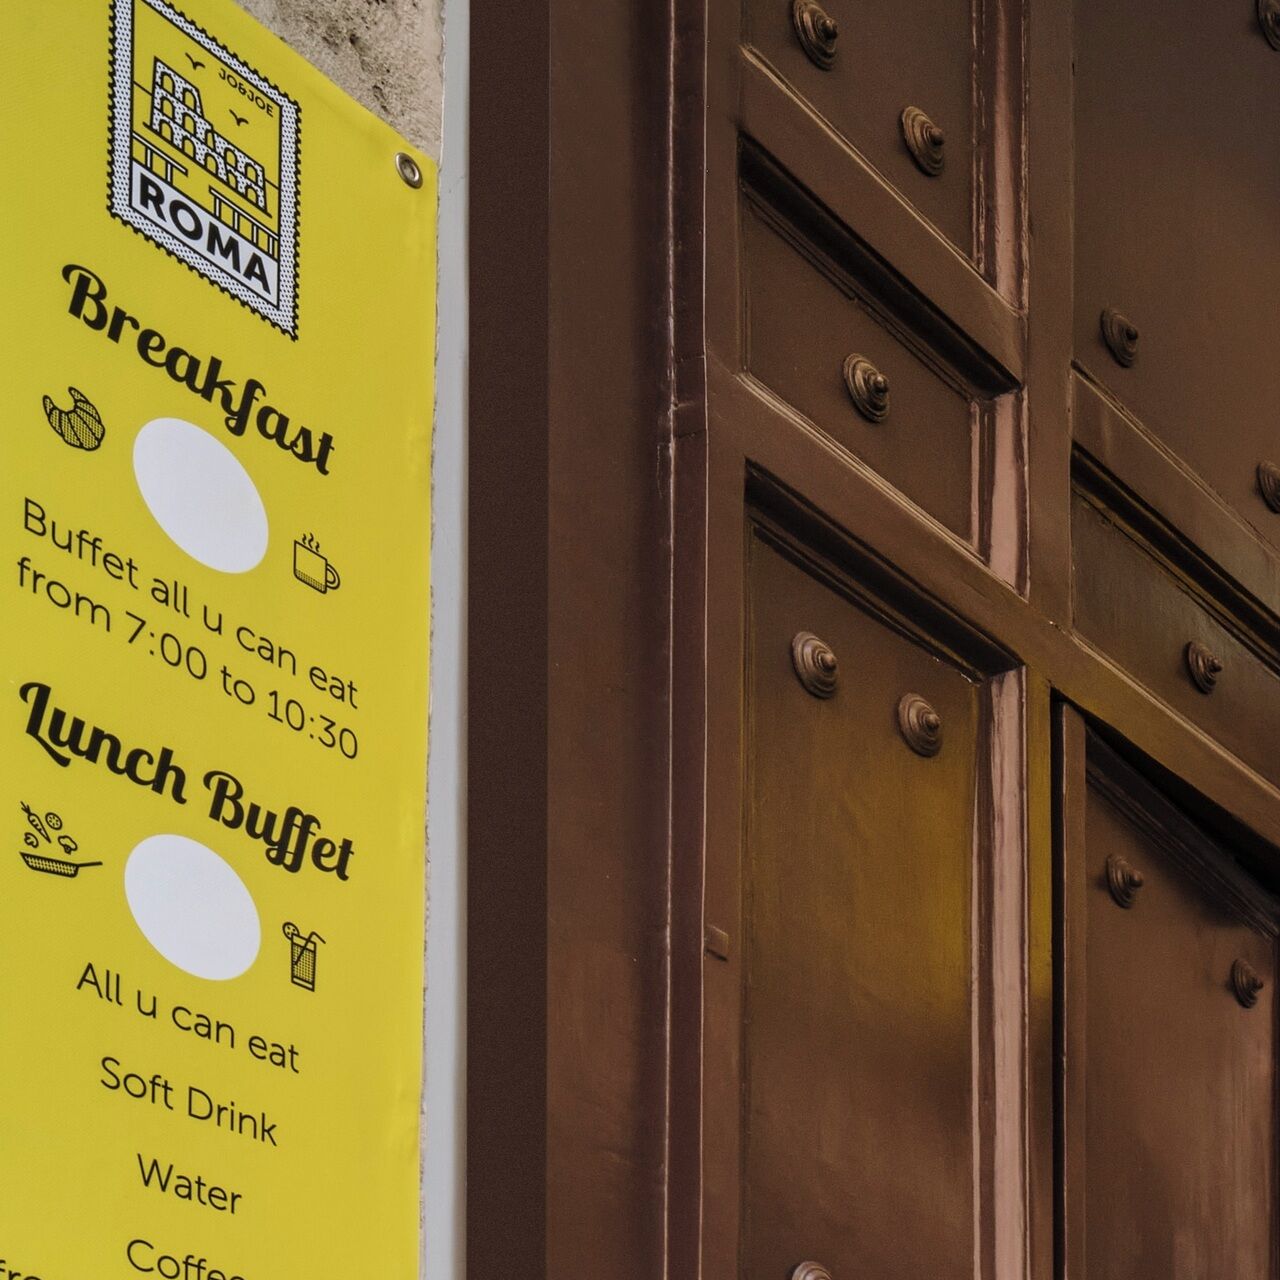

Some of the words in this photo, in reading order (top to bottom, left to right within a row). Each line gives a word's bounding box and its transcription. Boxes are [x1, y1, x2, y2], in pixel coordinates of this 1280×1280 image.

[140, 173, 271, 294] ROMA
[62, 264, 334, 475] Breakfast
[18, 557, 110, 631] from
[126, 612, 206, 679] 7:00
[221, 666, 255, 704] to
[268, 691, 357, 759] 10:30
[25, 498, 138, 589] Buffet
[151, 579, 189, 617] all
[204, 606, 221, 635] u
[237, 627, 295, 675] can
[310, 667, 357, 708] eat
[20, 683, 186, 804] Lunch
[204, 771, 354, 881] Buffet
[77, 963, 122, 1005] All
[138, 991, 156, 1018] u
[172, 1007, 234, 1048] can
[249, 1036, 298, 1073] eat
[101, 1057, 173, 1109] Soft
[189, 1087, 276, 1146] Drink
[138, 1154, 241, 1213] Water
